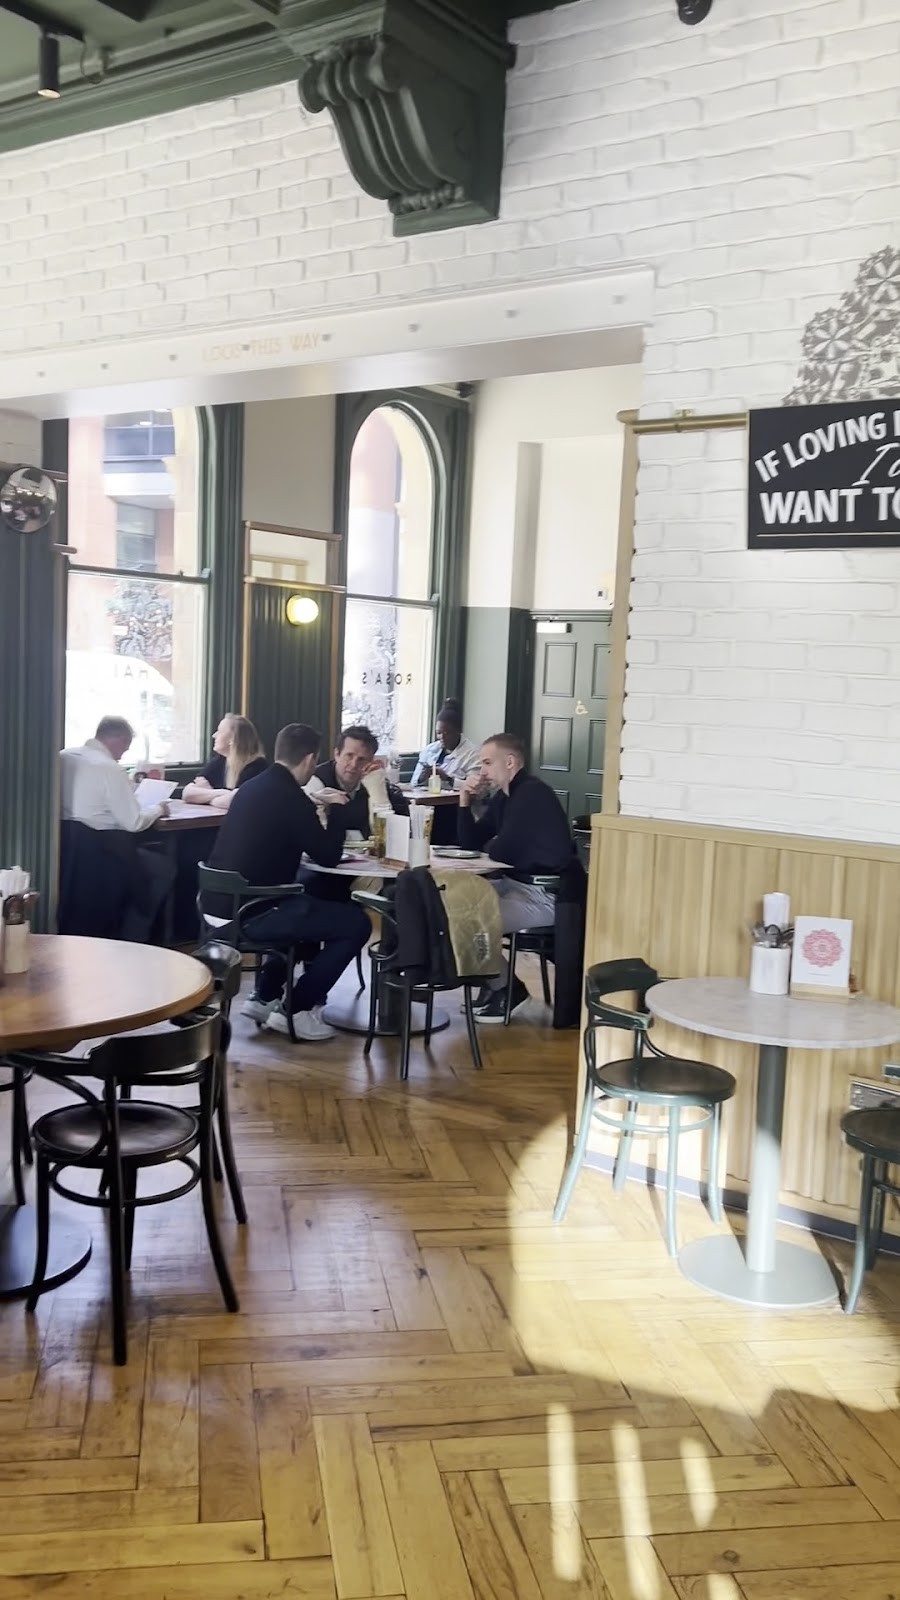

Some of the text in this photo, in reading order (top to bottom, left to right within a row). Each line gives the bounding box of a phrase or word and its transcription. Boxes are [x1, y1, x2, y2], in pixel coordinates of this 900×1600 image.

[289, 330, 320, 352] WAY
[754, 449, 780, 482] IF
[782, 411, 887, 468] LOVING
[759, 488, 863, 524] WANT
